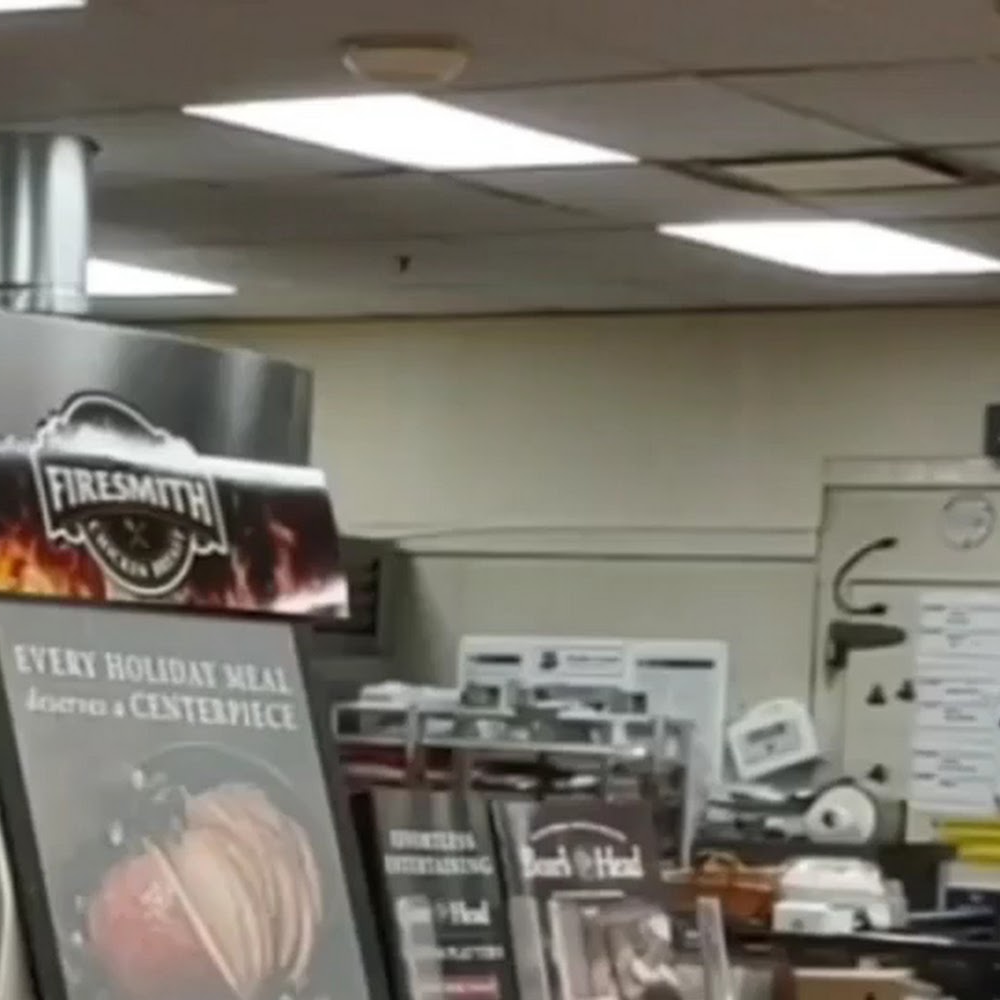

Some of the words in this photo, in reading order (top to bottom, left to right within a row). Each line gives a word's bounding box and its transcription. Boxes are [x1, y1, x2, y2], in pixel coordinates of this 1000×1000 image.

[46, 464, 212, 526] FIRESMITH
[14, 644, 96, 679] EVERY
[105, 652, 217, 688] HOLIDAY
[221, 662, 291, 695] MEAL
[130, 691, 297, 730] CENTERPIECE
[596, 844, 644, 879] Head
